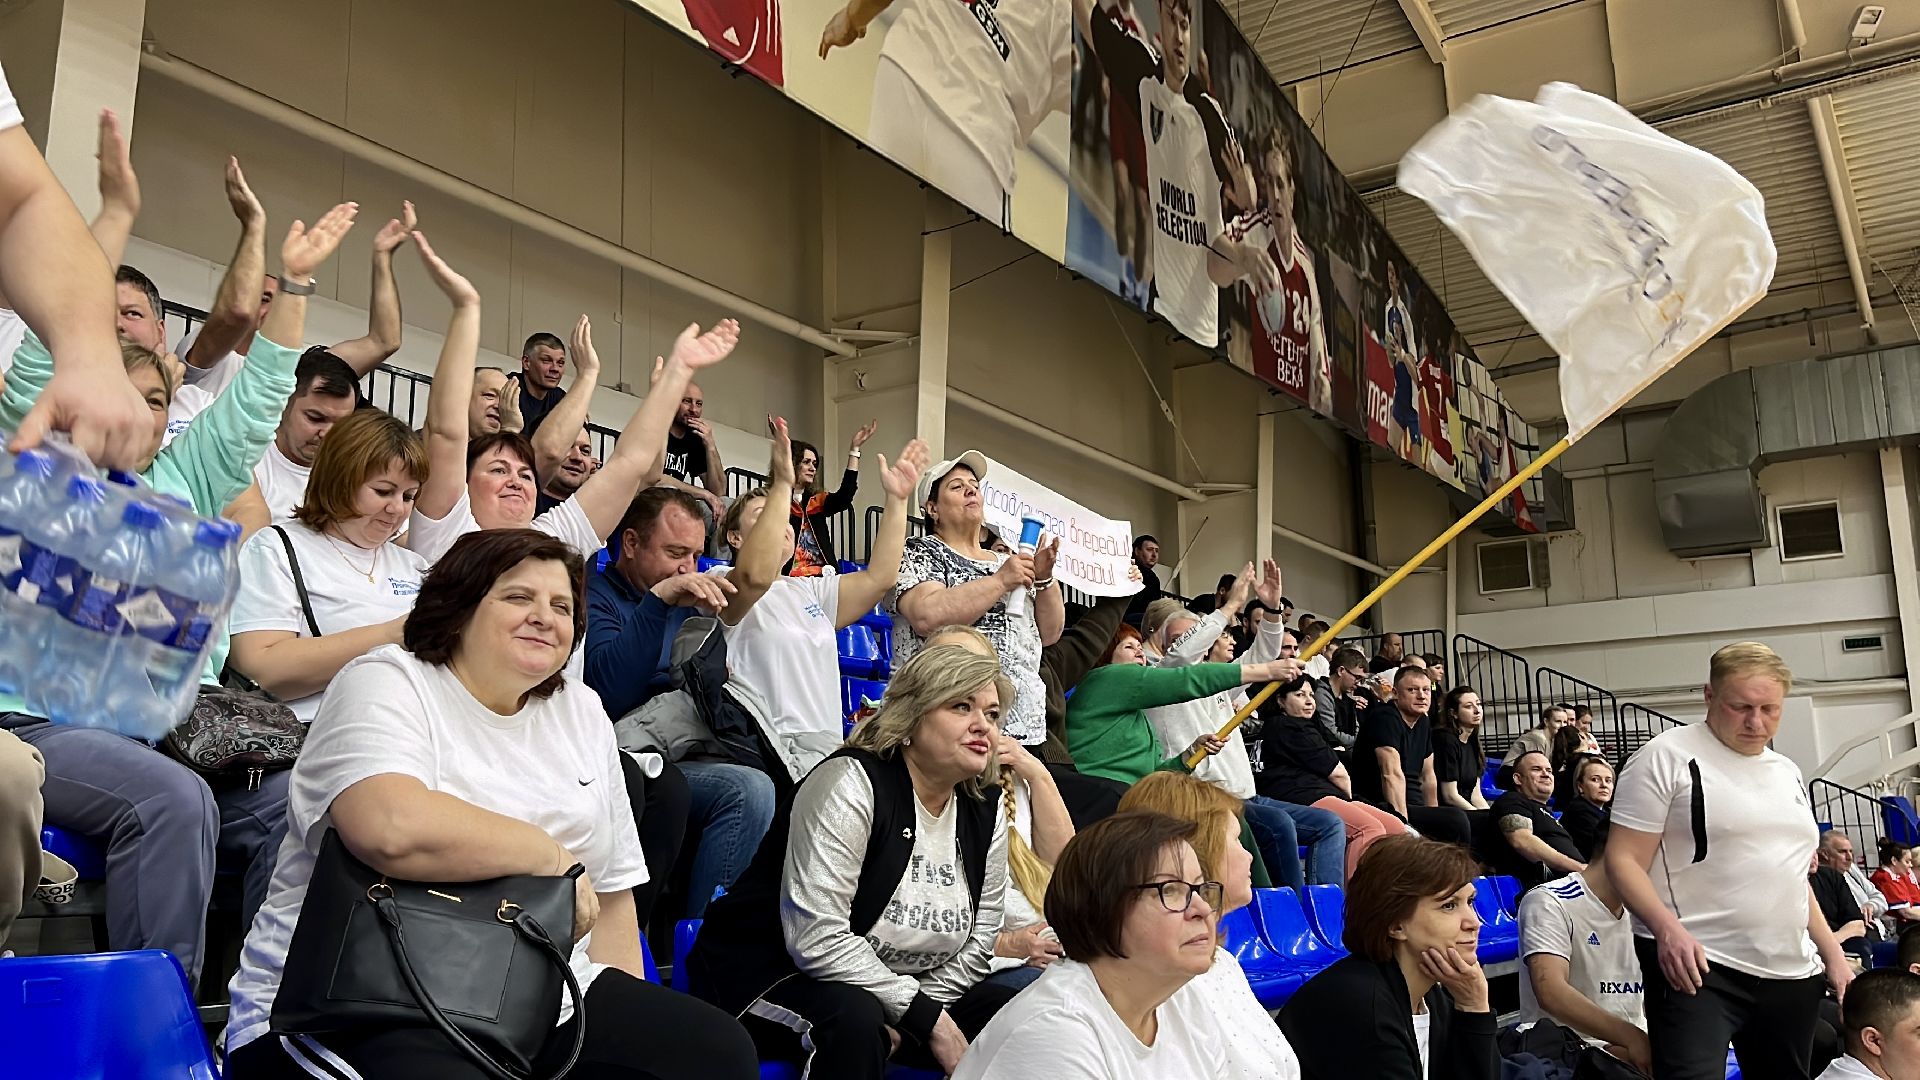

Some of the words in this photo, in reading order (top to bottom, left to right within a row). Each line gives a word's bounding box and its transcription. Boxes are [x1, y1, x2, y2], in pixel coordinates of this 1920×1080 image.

[1160, 177, 1196, 217] WORLD
[1156, 203, 1207, 246] SELECTION
[1277, 357, 1304, 389] ВЕКА
